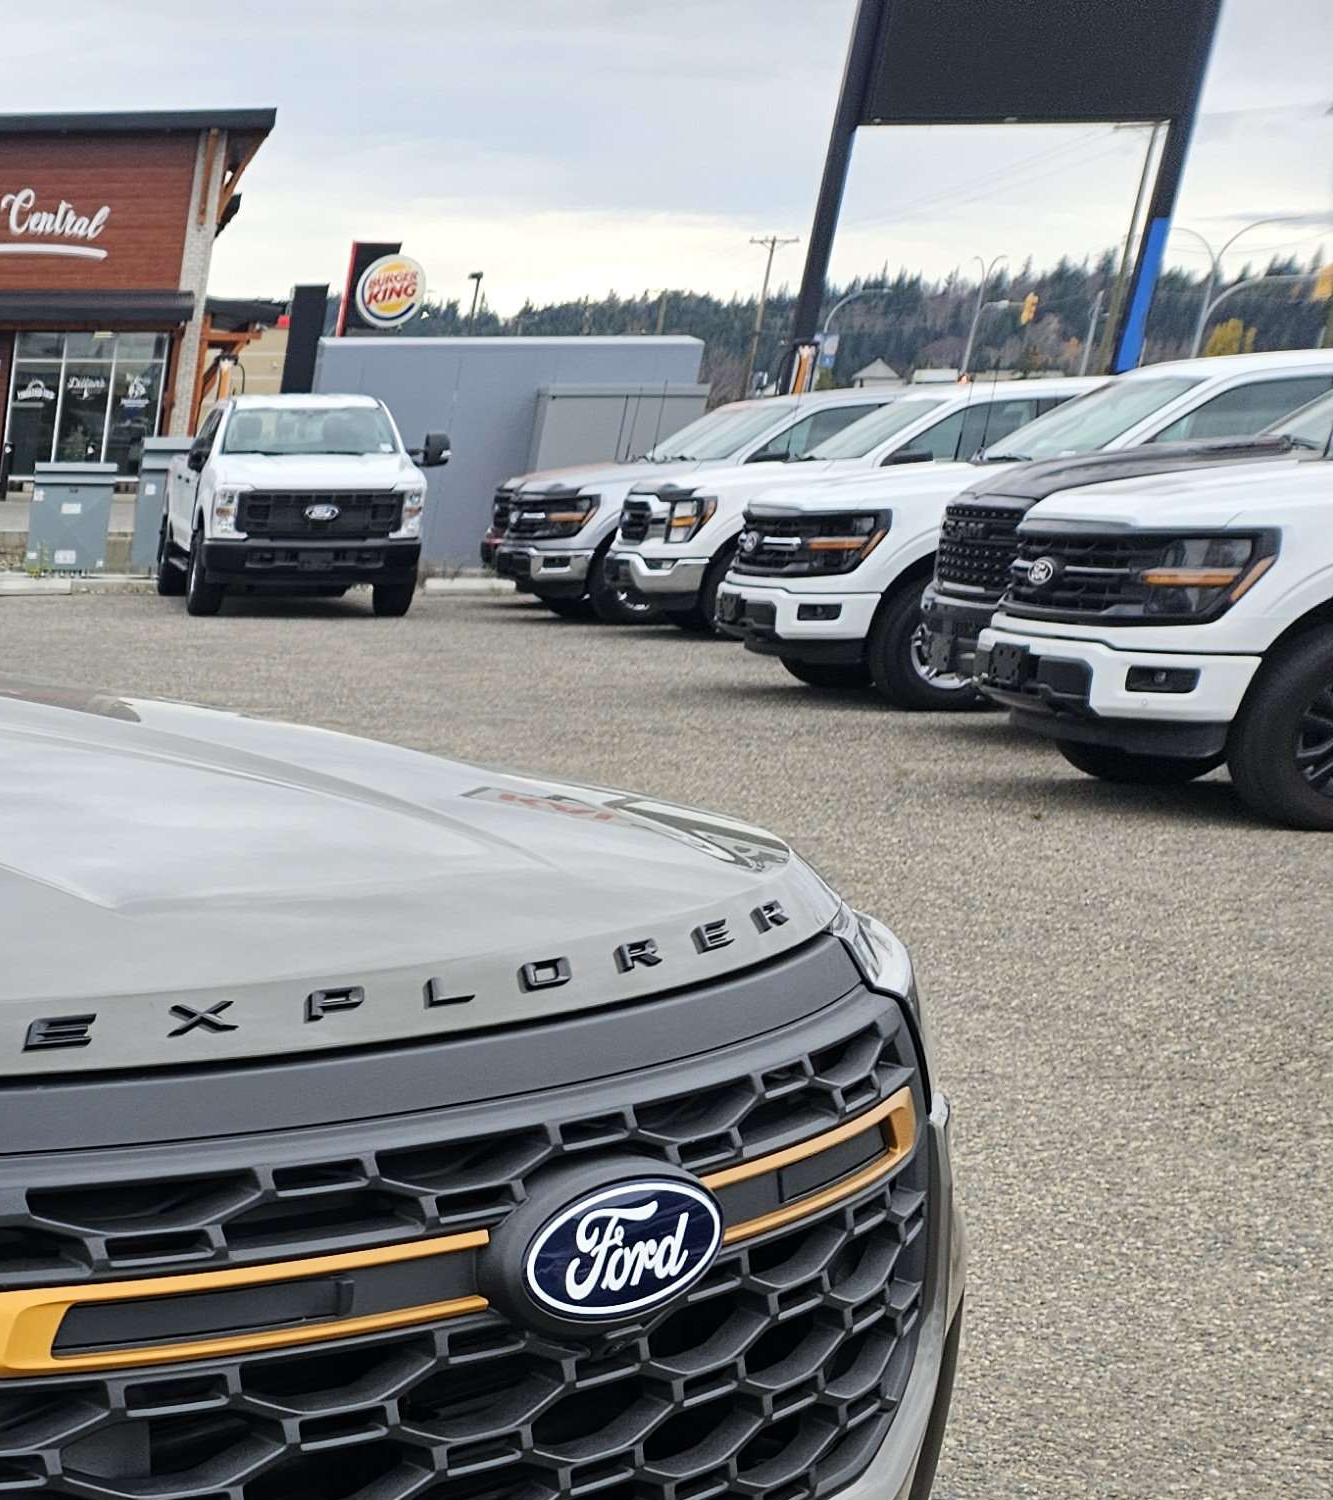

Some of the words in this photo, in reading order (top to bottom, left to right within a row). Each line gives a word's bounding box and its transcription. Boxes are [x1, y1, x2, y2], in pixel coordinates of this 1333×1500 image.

[0, 188, 111, 240] Central
[367, 281, 417, 305] KING
[369, 271, 418, 289] BURGER
[22, 899, 789, 1053] EXPLORER
[565, 1200, 689, 1300] Ford
